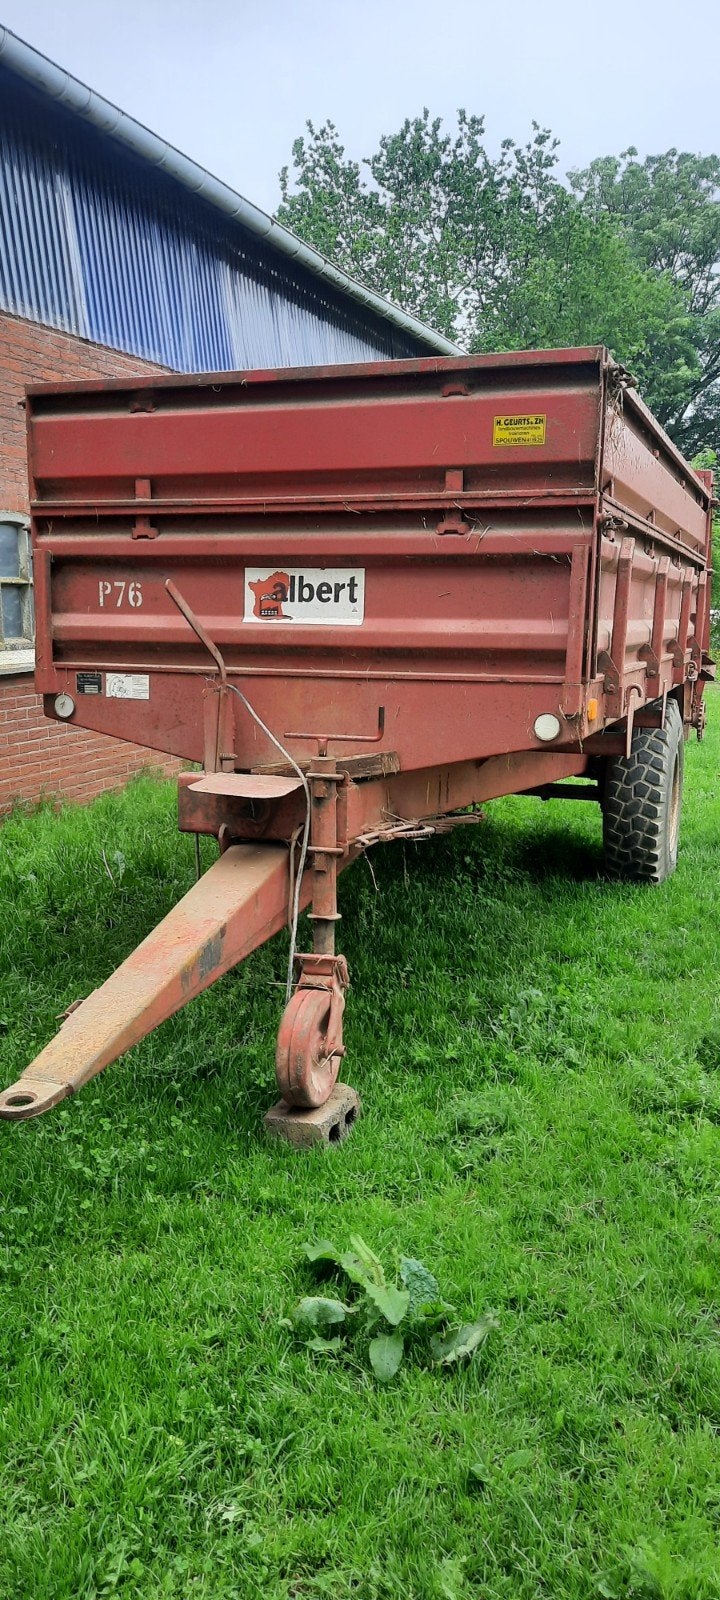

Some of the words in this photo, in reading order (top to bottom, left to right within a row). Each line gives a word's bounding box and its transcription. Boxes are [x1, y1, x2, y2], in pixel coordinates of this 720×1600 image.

[504, 418, 530, 426] GEURTS
[98, 581, 143, 607] P76
[273, 575, 358, 604] albert
